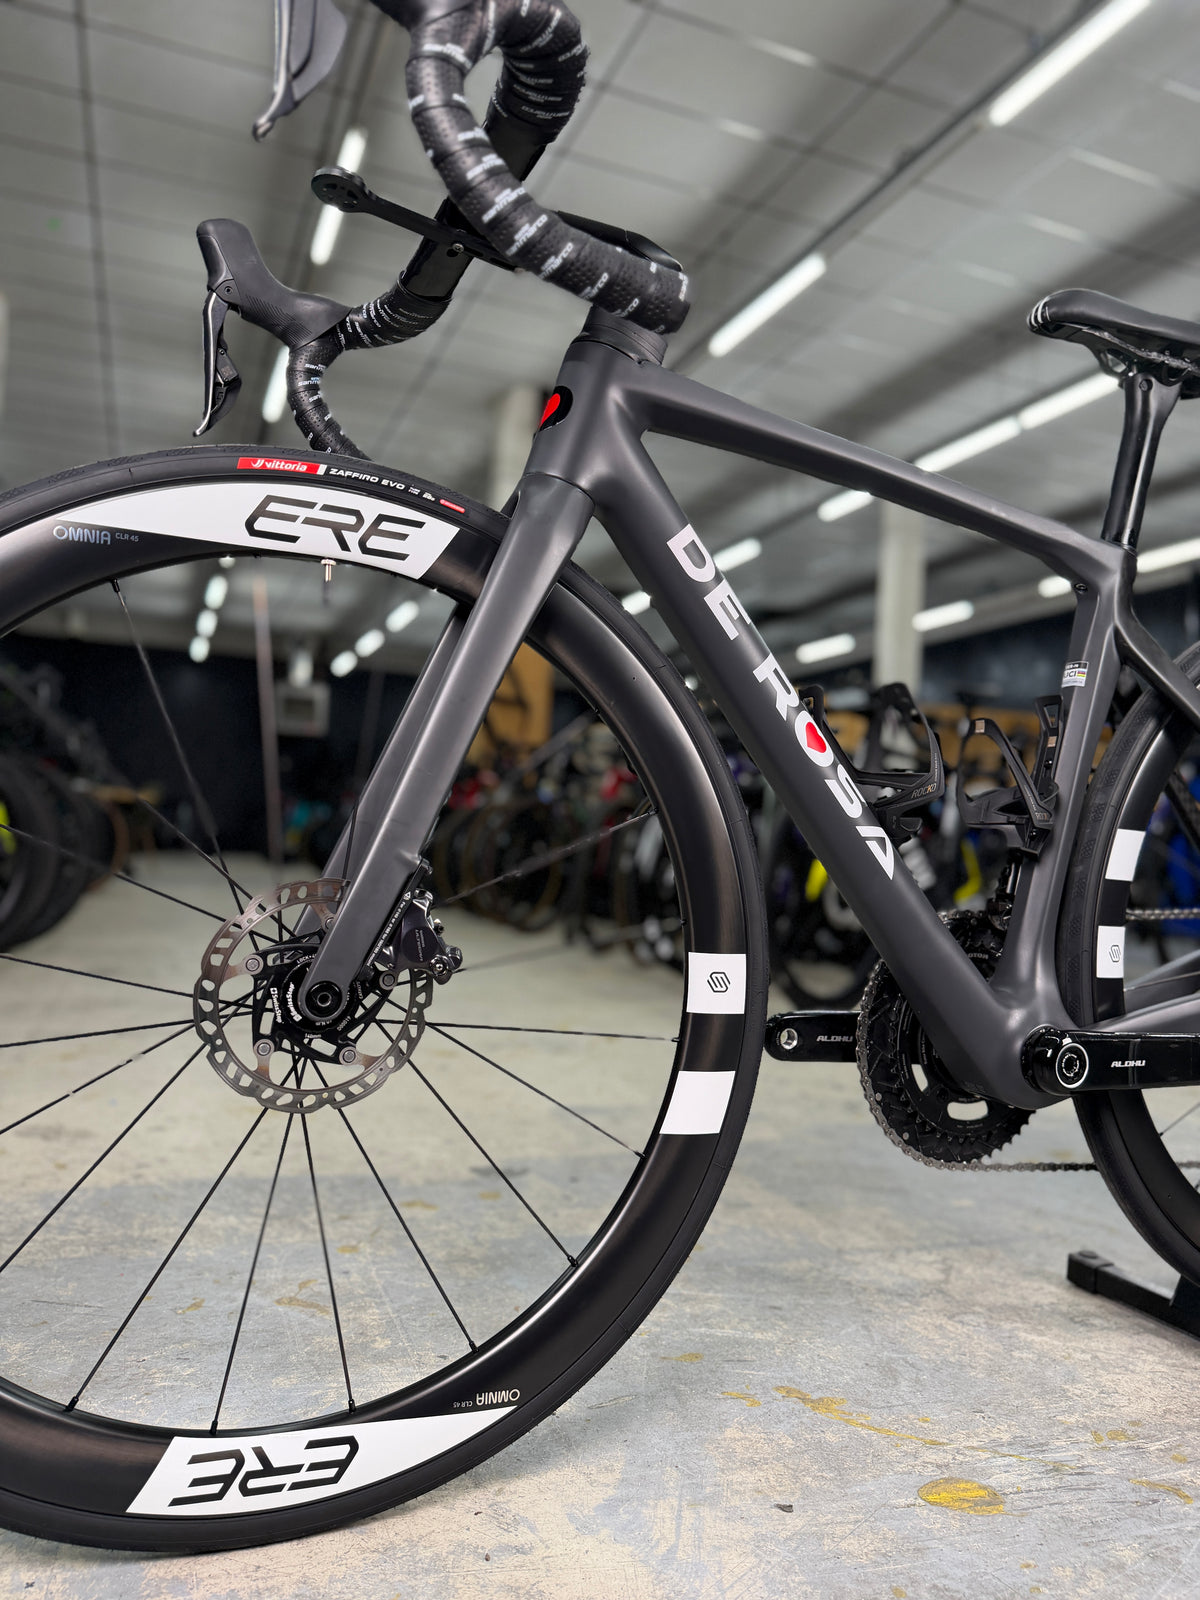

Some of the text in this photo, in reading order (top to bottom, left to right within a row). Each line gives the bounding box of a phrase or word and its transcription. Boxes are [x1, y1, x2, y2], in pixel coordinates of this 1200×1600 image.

[264, 460, 308, 472] vittoria
[329, 468, 406, 491] ZAFFIRO EVO
[53, 525, 111, 545] OMNIA
[115, 532, 129, 541] CLR
[244, 494, 426, 562] ERE
[667, 523, 895, 881] DE ROSA
[271, 994, 284, 1024] SwissStop
[816, 1035, 853, 1043] ALDHU
[1110, 1060, 1146, 1068] ALDHU
[461, 1400, 473, 1408] CLR
[476, 1389, 520, 1406] OMNIA
[167, 1435, 359, 1507] ERE
